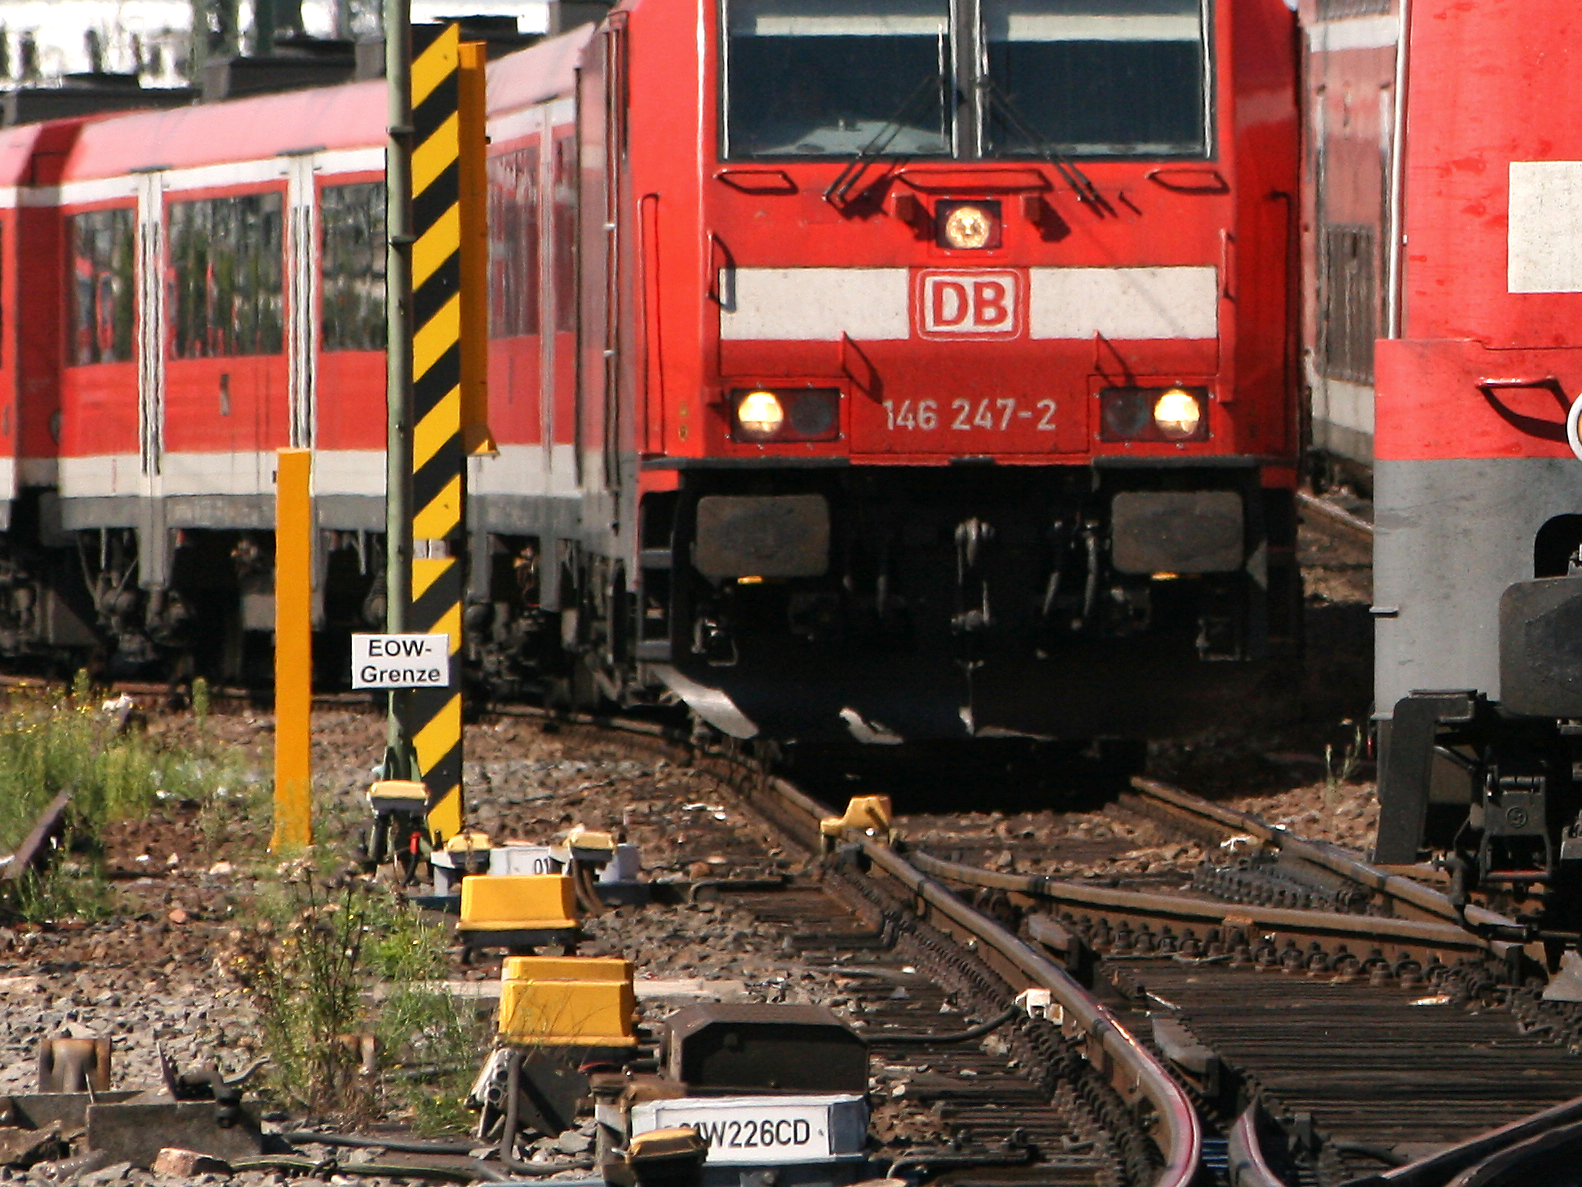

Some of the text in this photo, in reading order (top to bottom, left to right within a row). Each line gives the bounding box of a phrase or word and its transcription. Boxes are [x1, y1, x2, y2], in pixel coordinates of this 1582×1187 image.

[932, 281, 1008, 327] DB
[882, 397, 1058, 432] 146 247-2
[368, 639, 433, 657] EOW-
[360, 664, 441, 684] Grenze
